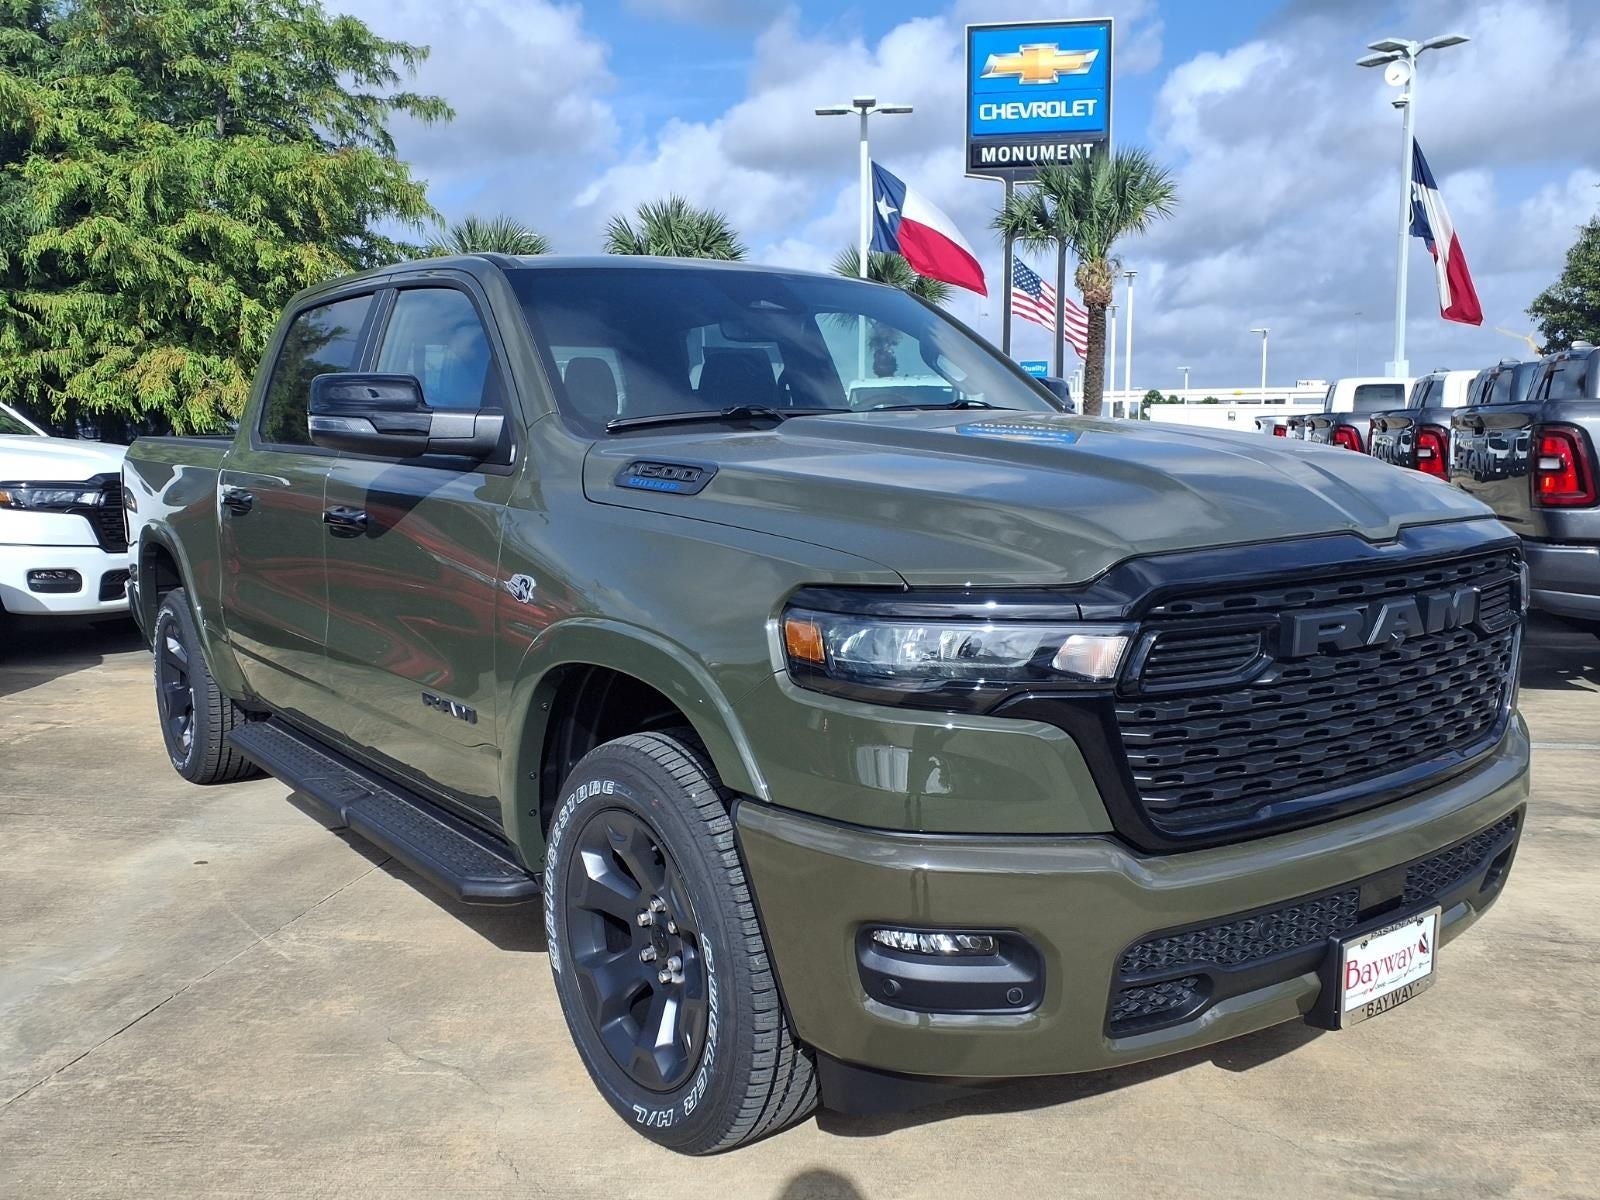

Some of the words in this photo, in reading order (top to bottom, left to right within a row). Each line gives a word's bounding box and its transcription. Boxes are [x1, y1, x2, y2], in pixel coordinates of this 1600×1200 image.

[980, 99, 1097, 120] CHEVROLET
[981, 143, 1093, 162] MONUMENT
[1456, 451, 1495, 472] RAM
[1280, 584, 1481, 658] RAM
[421, 691, 478, 724] RAM
[544, 780, 615, 974] BRIDGESTONE
[1345, 944, 1416, 992] Bayway
[1366, 982, 1415, 1017] BAYWAY
[683, 933, 720, 1116] DUELER
